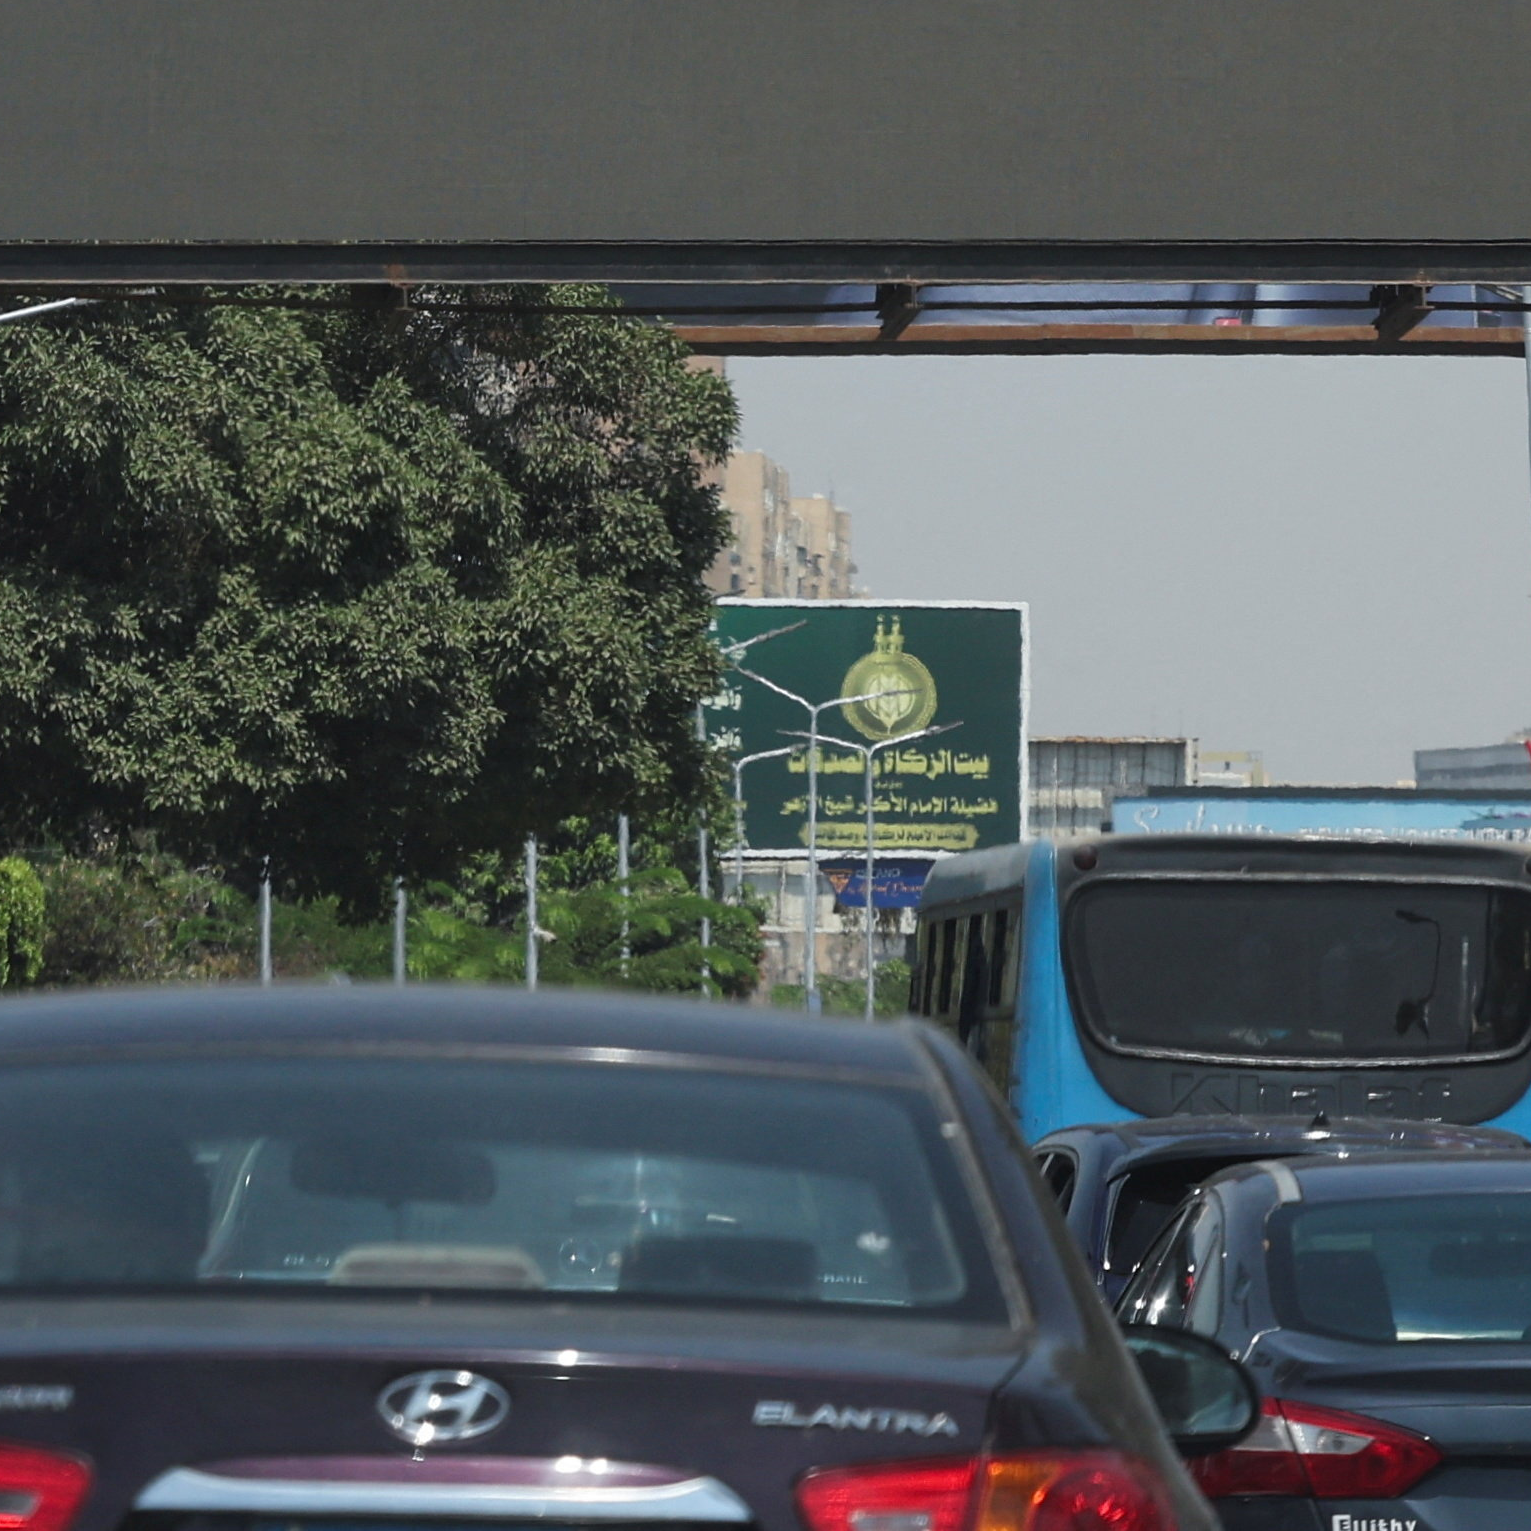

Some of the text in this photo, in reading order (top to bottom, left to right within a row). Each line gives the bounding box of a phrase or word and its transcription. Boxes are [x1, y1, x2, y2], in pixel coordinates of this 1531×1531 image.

[883, 747, 952, 781] الزكاة
[953, 752, 990, 780] بيت
[752, 1399, 960, 1438] ELANTRA
